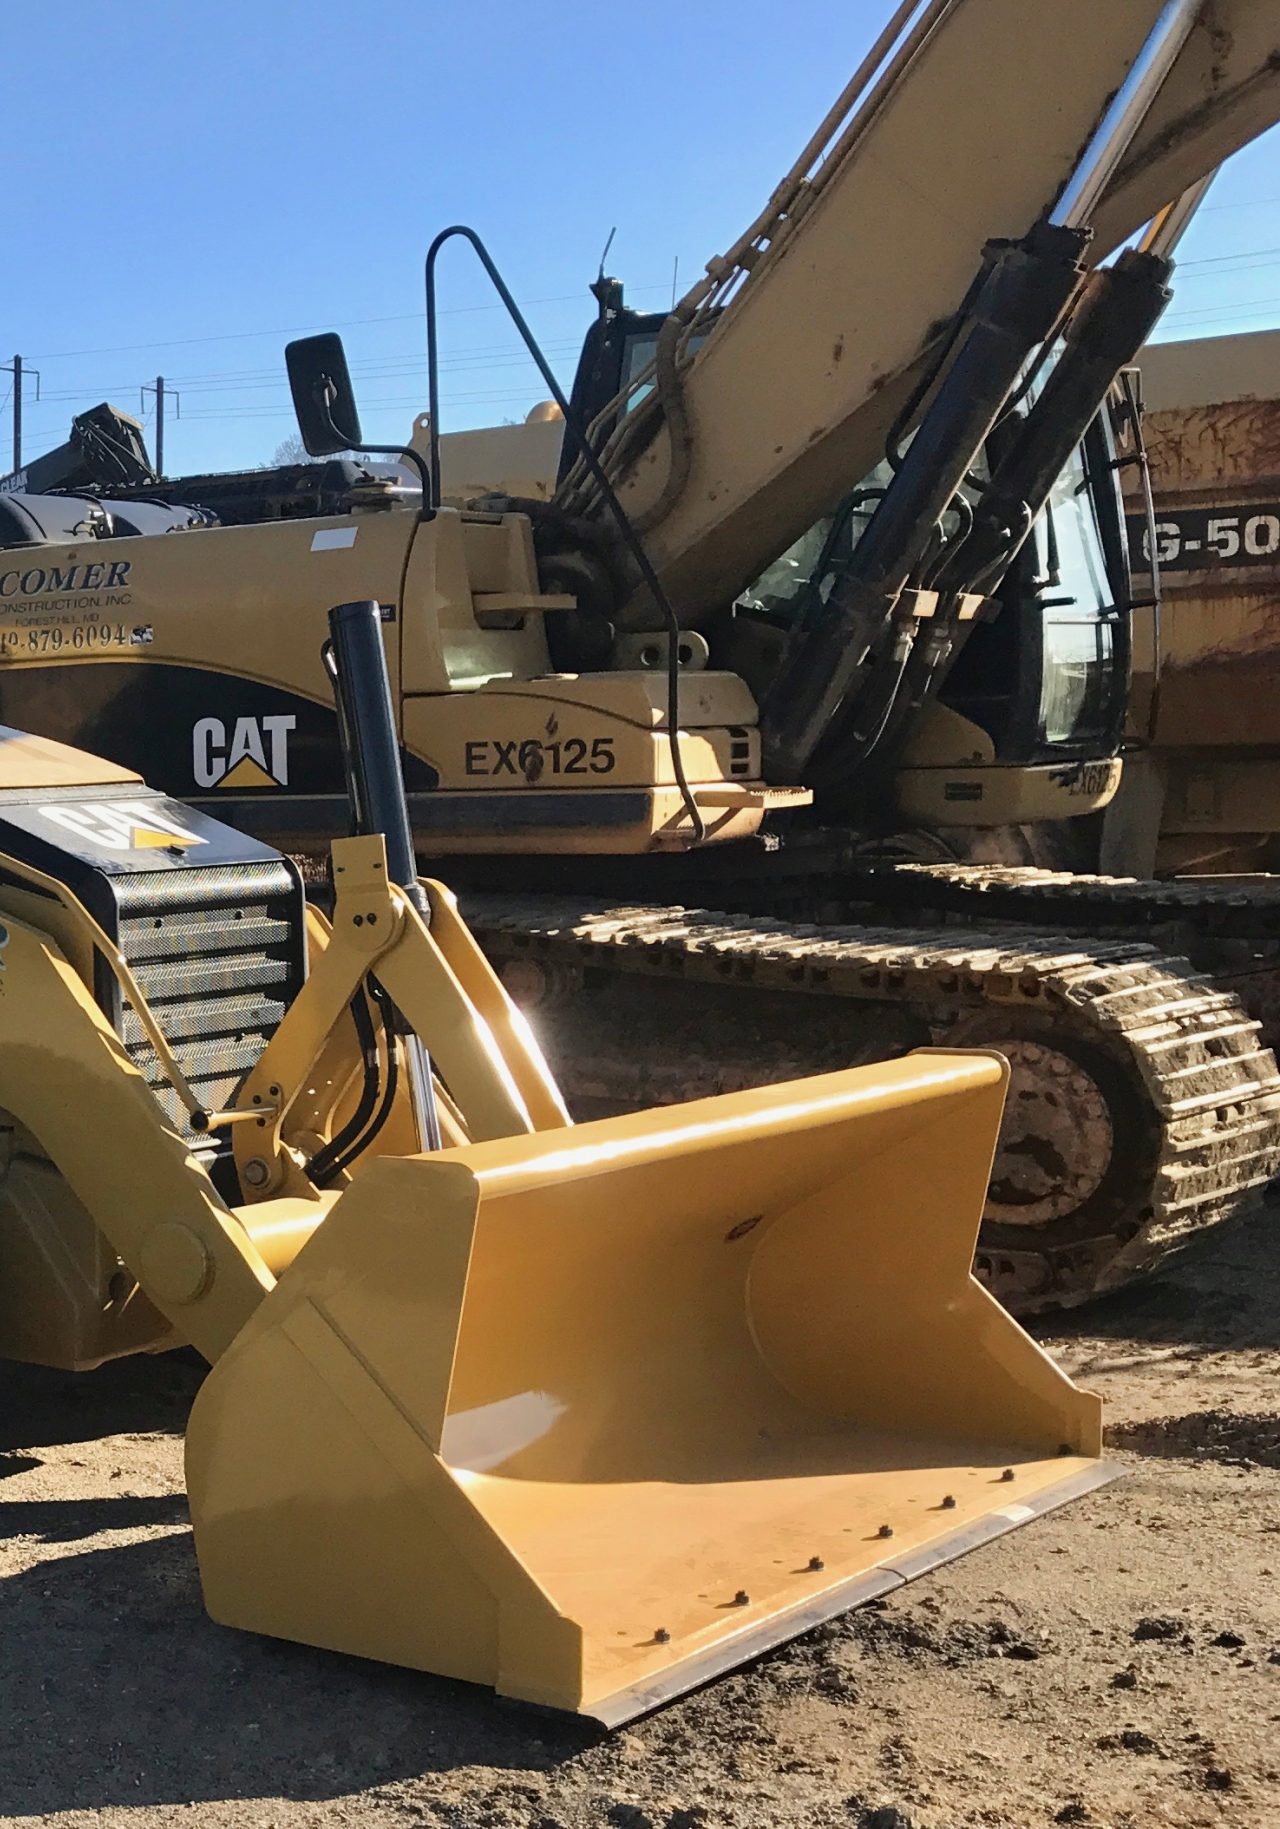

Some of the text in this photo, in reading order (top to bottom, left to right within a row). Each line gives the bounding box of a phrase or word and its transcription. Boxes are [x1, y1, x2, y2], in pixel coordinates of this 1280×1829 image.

[1143, 515, 1280, 562] G-50
[193, 715, 296, 788] CAT
[465, 738, 615, 776] EX6125
[38, 802, 210, 850] CAT
